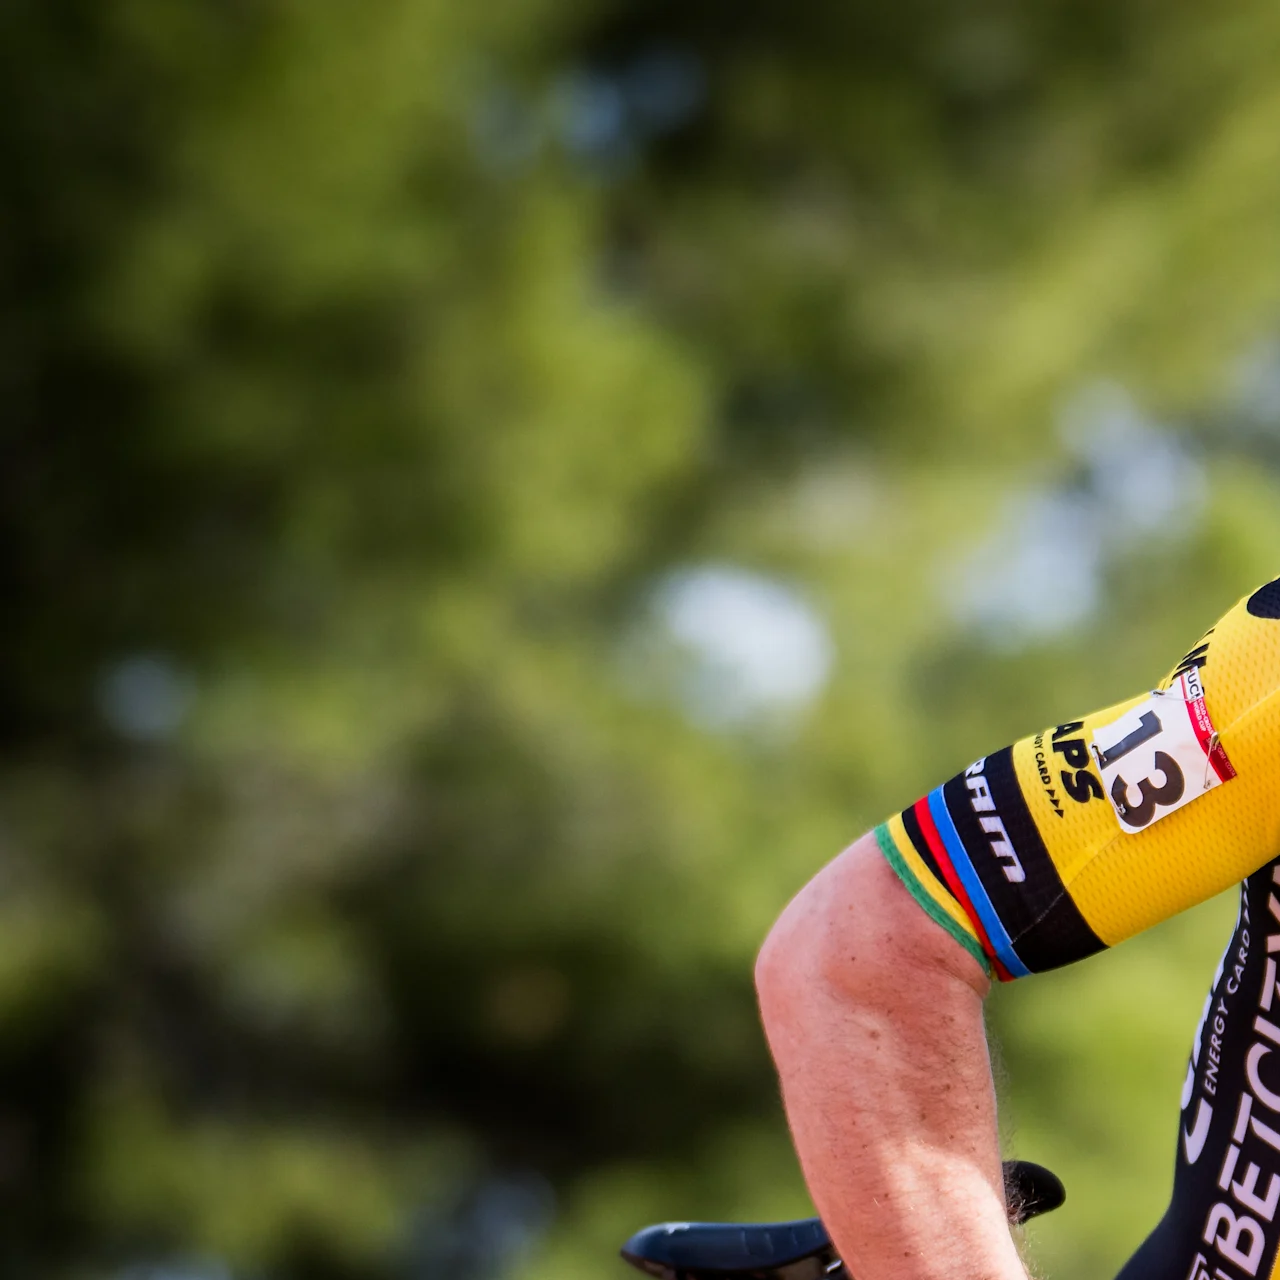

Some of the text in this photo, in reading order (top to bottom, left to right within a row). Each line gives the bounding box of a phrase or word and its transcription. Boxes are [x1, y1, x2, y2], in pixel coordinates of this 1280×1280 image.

[1035, 752, 1052, 785] CARD
[1100, 710, 1186, 828] 13
[1203, 930, 1251, 1096] ENERGY CARD
